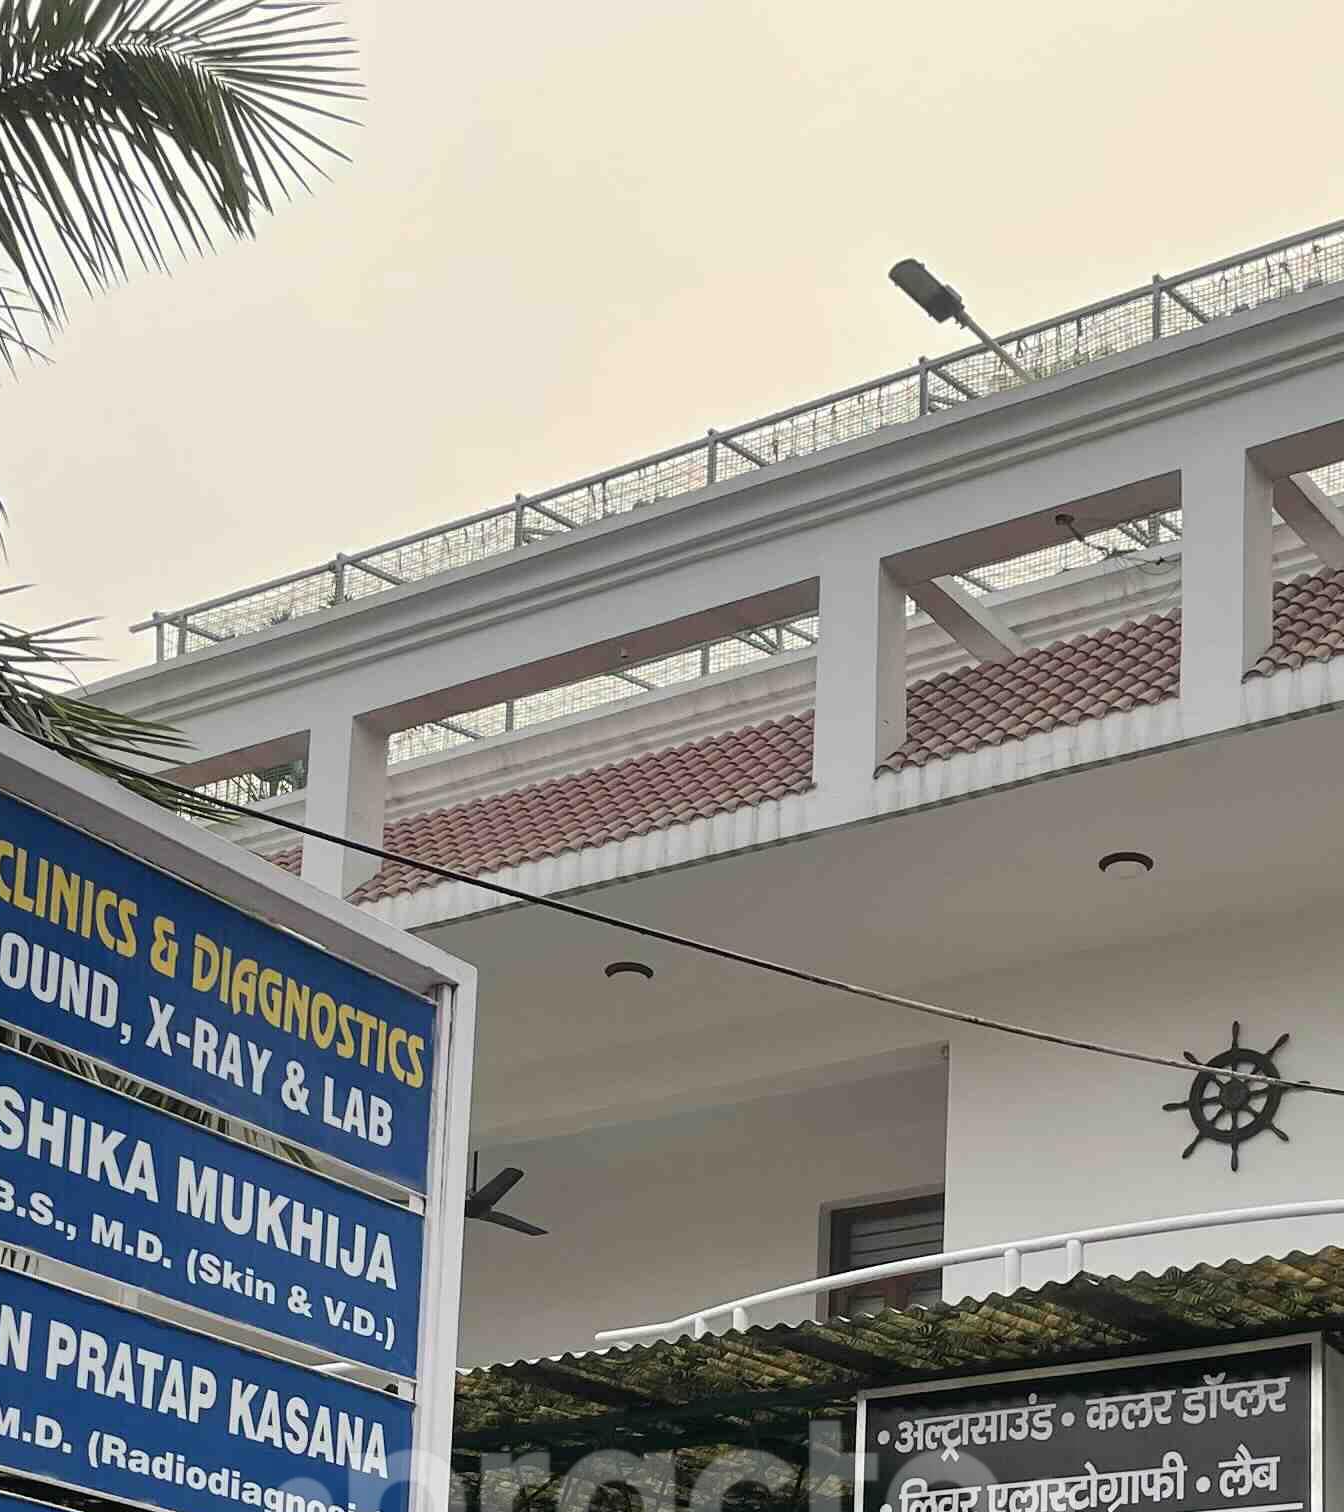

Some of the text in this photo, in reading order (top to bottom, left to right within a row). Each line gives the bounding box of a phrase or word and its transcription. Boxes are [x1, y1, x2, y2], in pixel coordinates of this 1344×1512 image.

[144, 994, 274, 1097] X-RAY
[281, 1059, 310, 1117] &
[323, 1074, 394, 1148] LAB
[150, 915, 178, 979] &
[192, 932, 426, 1090] DIAGNOSTICS
[90, 1212, 173, 1270] M.D.
[186, 1247, 277, 1306] (Skin
[286, 1284, 314, 1320] &
[323, 1294, 396, 1352] V.D.)
[175, 1155, 398, 1292] MUKHIJA
[44, 1318, 218, 1425] PRATAP
[227, 1377, 390, 1481] KASANA
[893, 1371, 1292, 1463] अल्ट्रासाउंड कलर डॉप्लर
[1218, 1442, 1282, 1498] लैब
